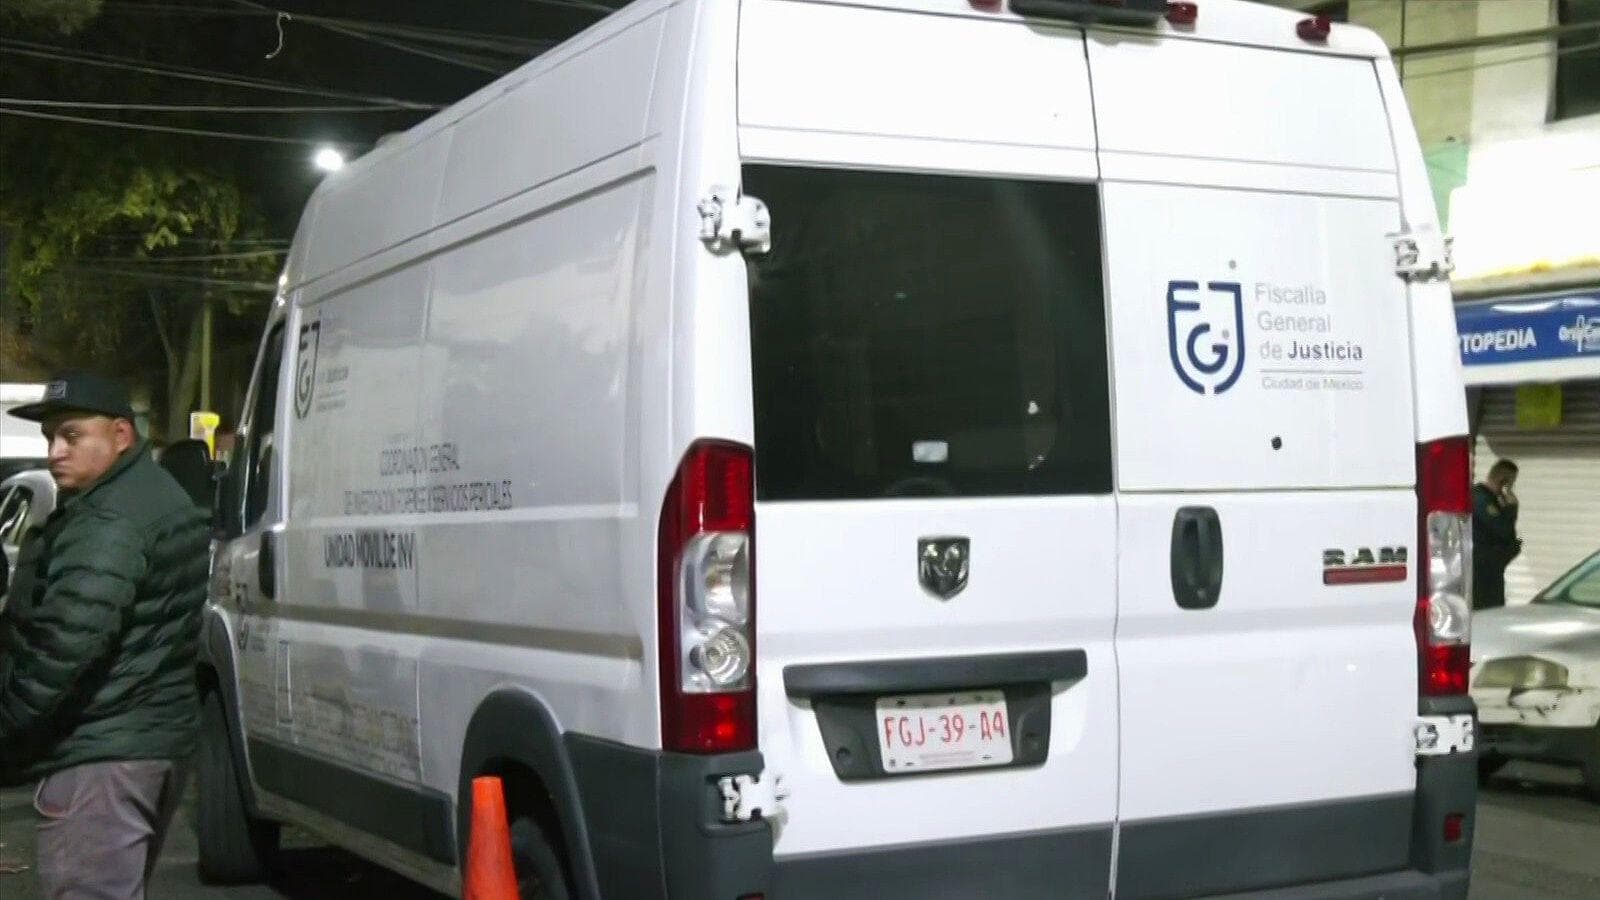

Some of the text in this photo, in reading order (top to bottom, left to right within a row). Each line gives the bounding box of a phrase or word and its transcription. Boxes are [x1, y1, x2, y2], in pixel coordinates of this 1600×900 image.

[1257, 310, 1331, 333] General
[1260, 340, 1363, 360] de Justicia
[1323, 547, 1408, 565] RAM
